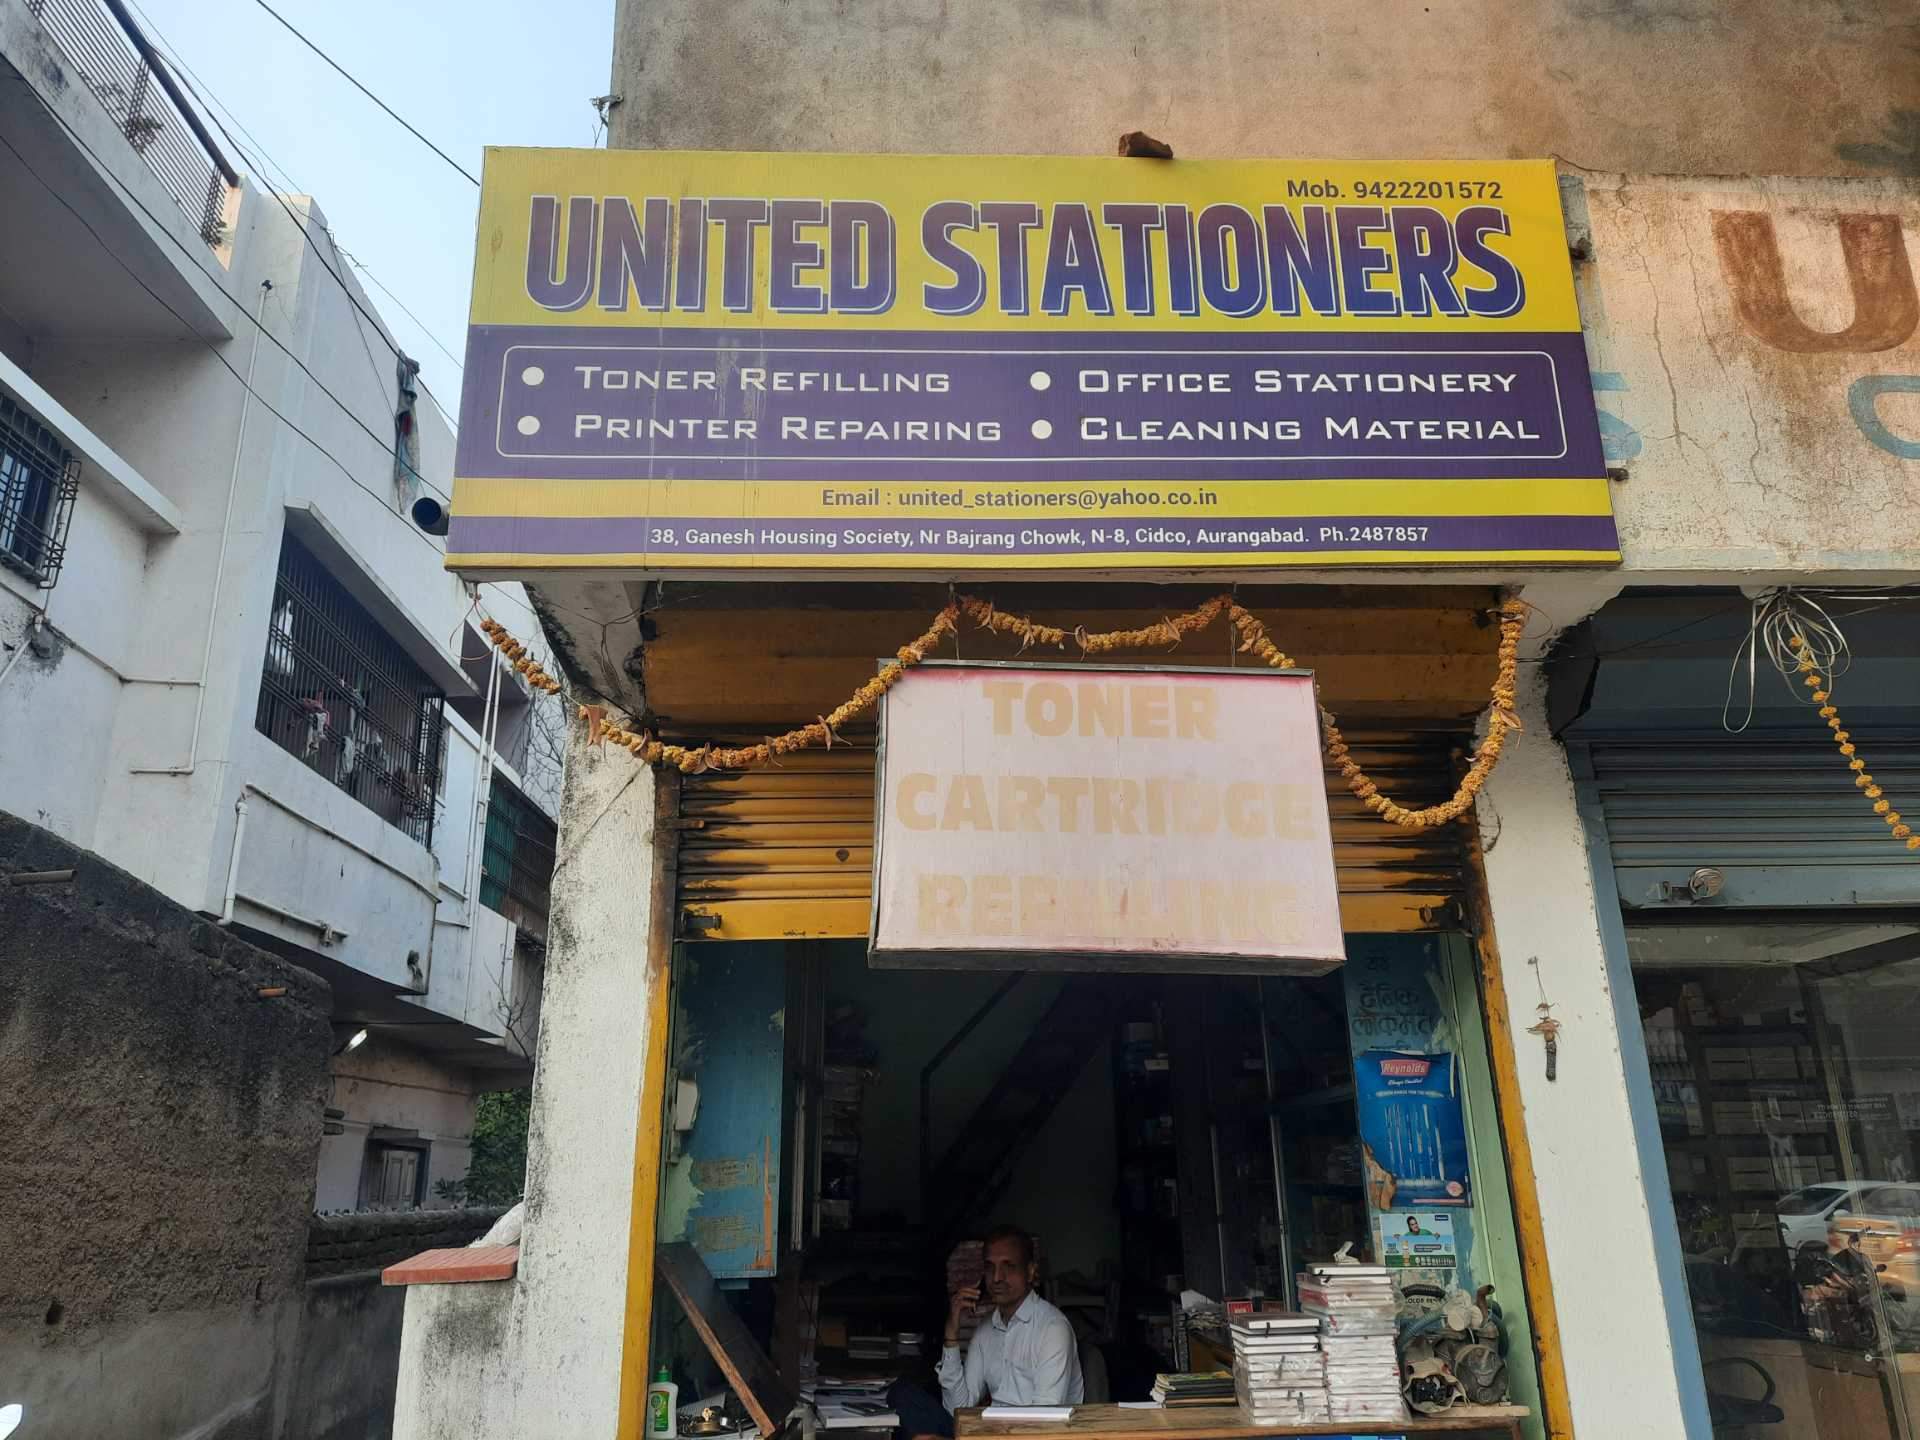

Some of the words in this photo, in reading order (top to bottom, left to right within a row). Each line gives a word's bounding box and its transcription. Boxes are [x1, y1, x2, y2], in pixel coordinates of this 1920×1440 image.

[1287, 179, 1346, 198] Mob.
[1353, 180, 1503, 199] 9422201572
[526, 195, 897, 315] UNITED
[920, 200, 1527, 318] STATIONERS
[574, 365, 717, 392] TONER
[740, 366, 951, 393] REFILLING
[1078, 369, 1232, 394] OFFICE
[1253, 369, 1518, 394] STATIONERY
[574, 414, 758, 440] PRINTER
[781, 415, 1002, 441] REPAIRING
[1079, 416, 1301, 441] CLEANING
[1324, 416, 1541, 440] MATERIAL
[821, 487, 880, 506] Email
[898, 487, 1218, 510] united_stationers@yahoo.co.in
[650, 528, 680, 546] 38,
[685, 528, 755, 545] Ganesh
[761, 529, 837, 548] Housing
[843, 529, 914, 548] Society,
[919, 529, 940, 545] Nr
[946, 529, 1015, 549] Bajrang
[1020, 529, 1086, 547] Chowk,
[1091, 528, 1130, 546] N-8,
[1135, 527, 1191, 546] Cidco,
[1196, 527, 1310, 547] Aurangabad.
[1319, 525, 1429, 543] Ph.2487857
[982, 681, 1219, 740] TONER
[896, 772, 1316, 842] CARTRIDGE
[1383, 1063, 1425, 1075] Reynolds
